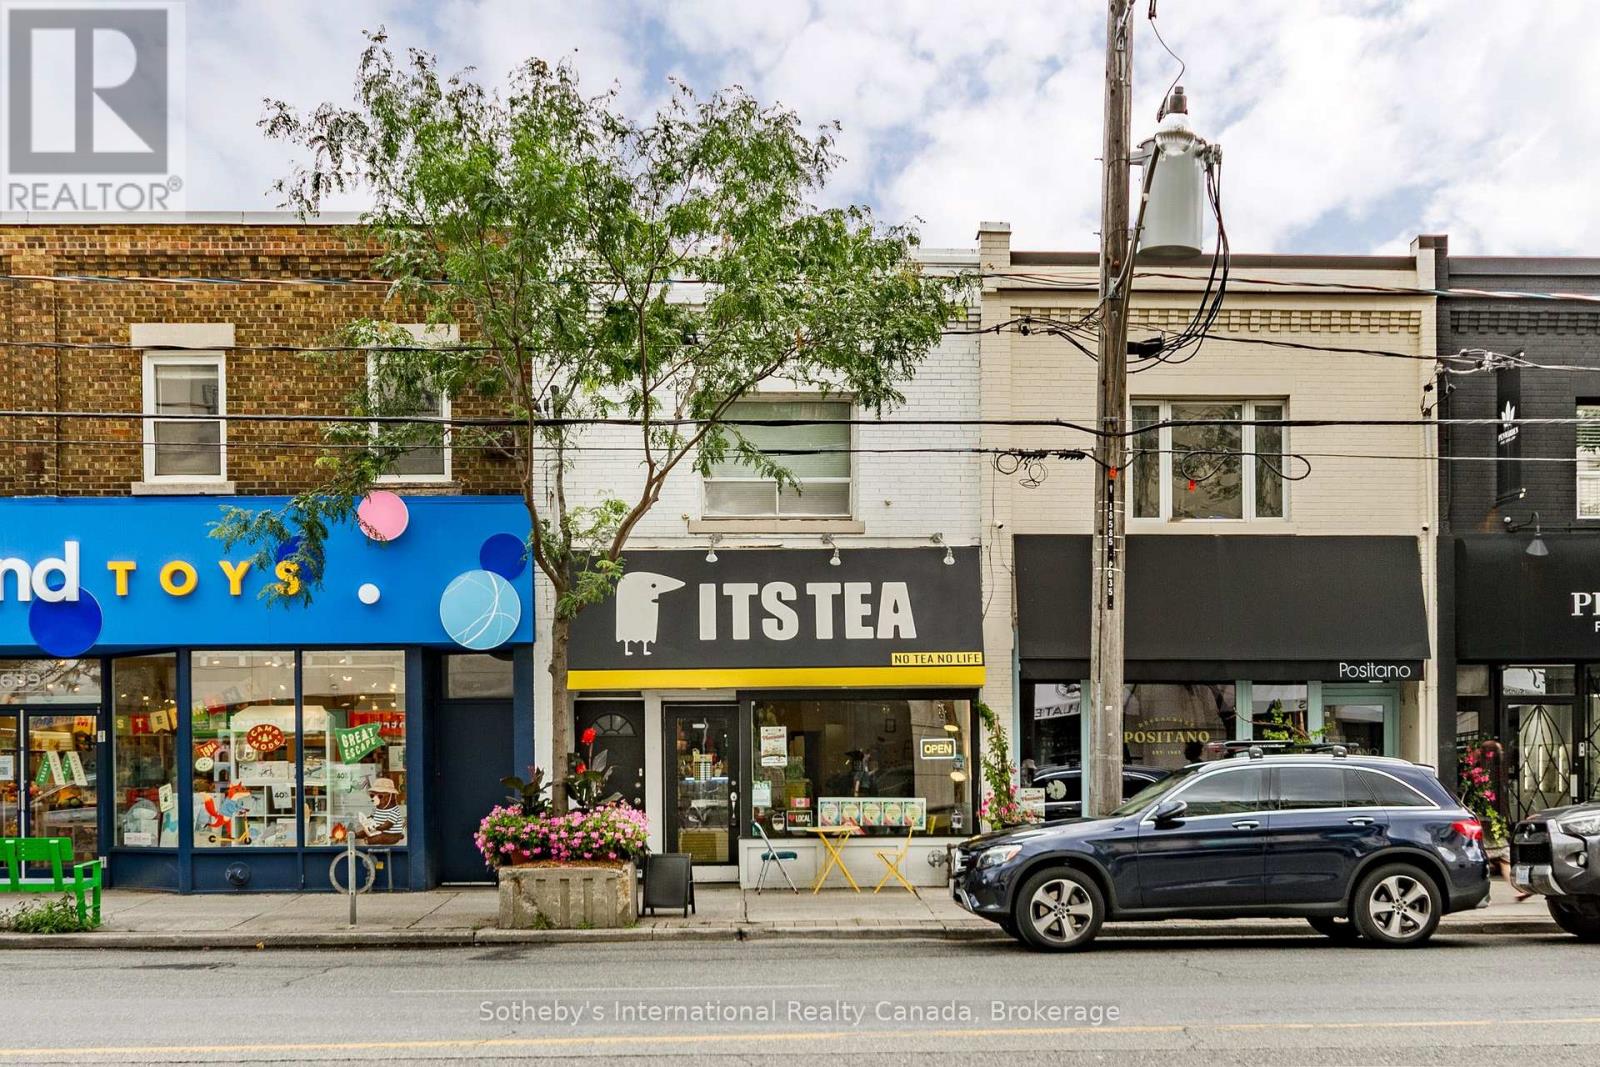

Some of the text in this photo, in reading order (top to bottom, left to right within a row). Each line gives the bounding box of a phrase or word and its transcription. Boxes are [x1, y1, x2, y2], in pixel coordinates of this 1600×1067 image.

[106, 560, 301, 596] TOYS
[894, 653, 981, 664] NO TEA NO LIFE
[1339, 662, 1411, 678] Positano
[251, 725, 279, 737] CAMP
[1124, 731, 1210, 743] POSITANO
[341, 727, 374, 748] GREAT
[251, 739, 280, 750] MODE
[345, 737, 376, 760] ESCAPE
[924, 744, 952, 754] OPEN
[795, 815, 810, 823] LOCAL
